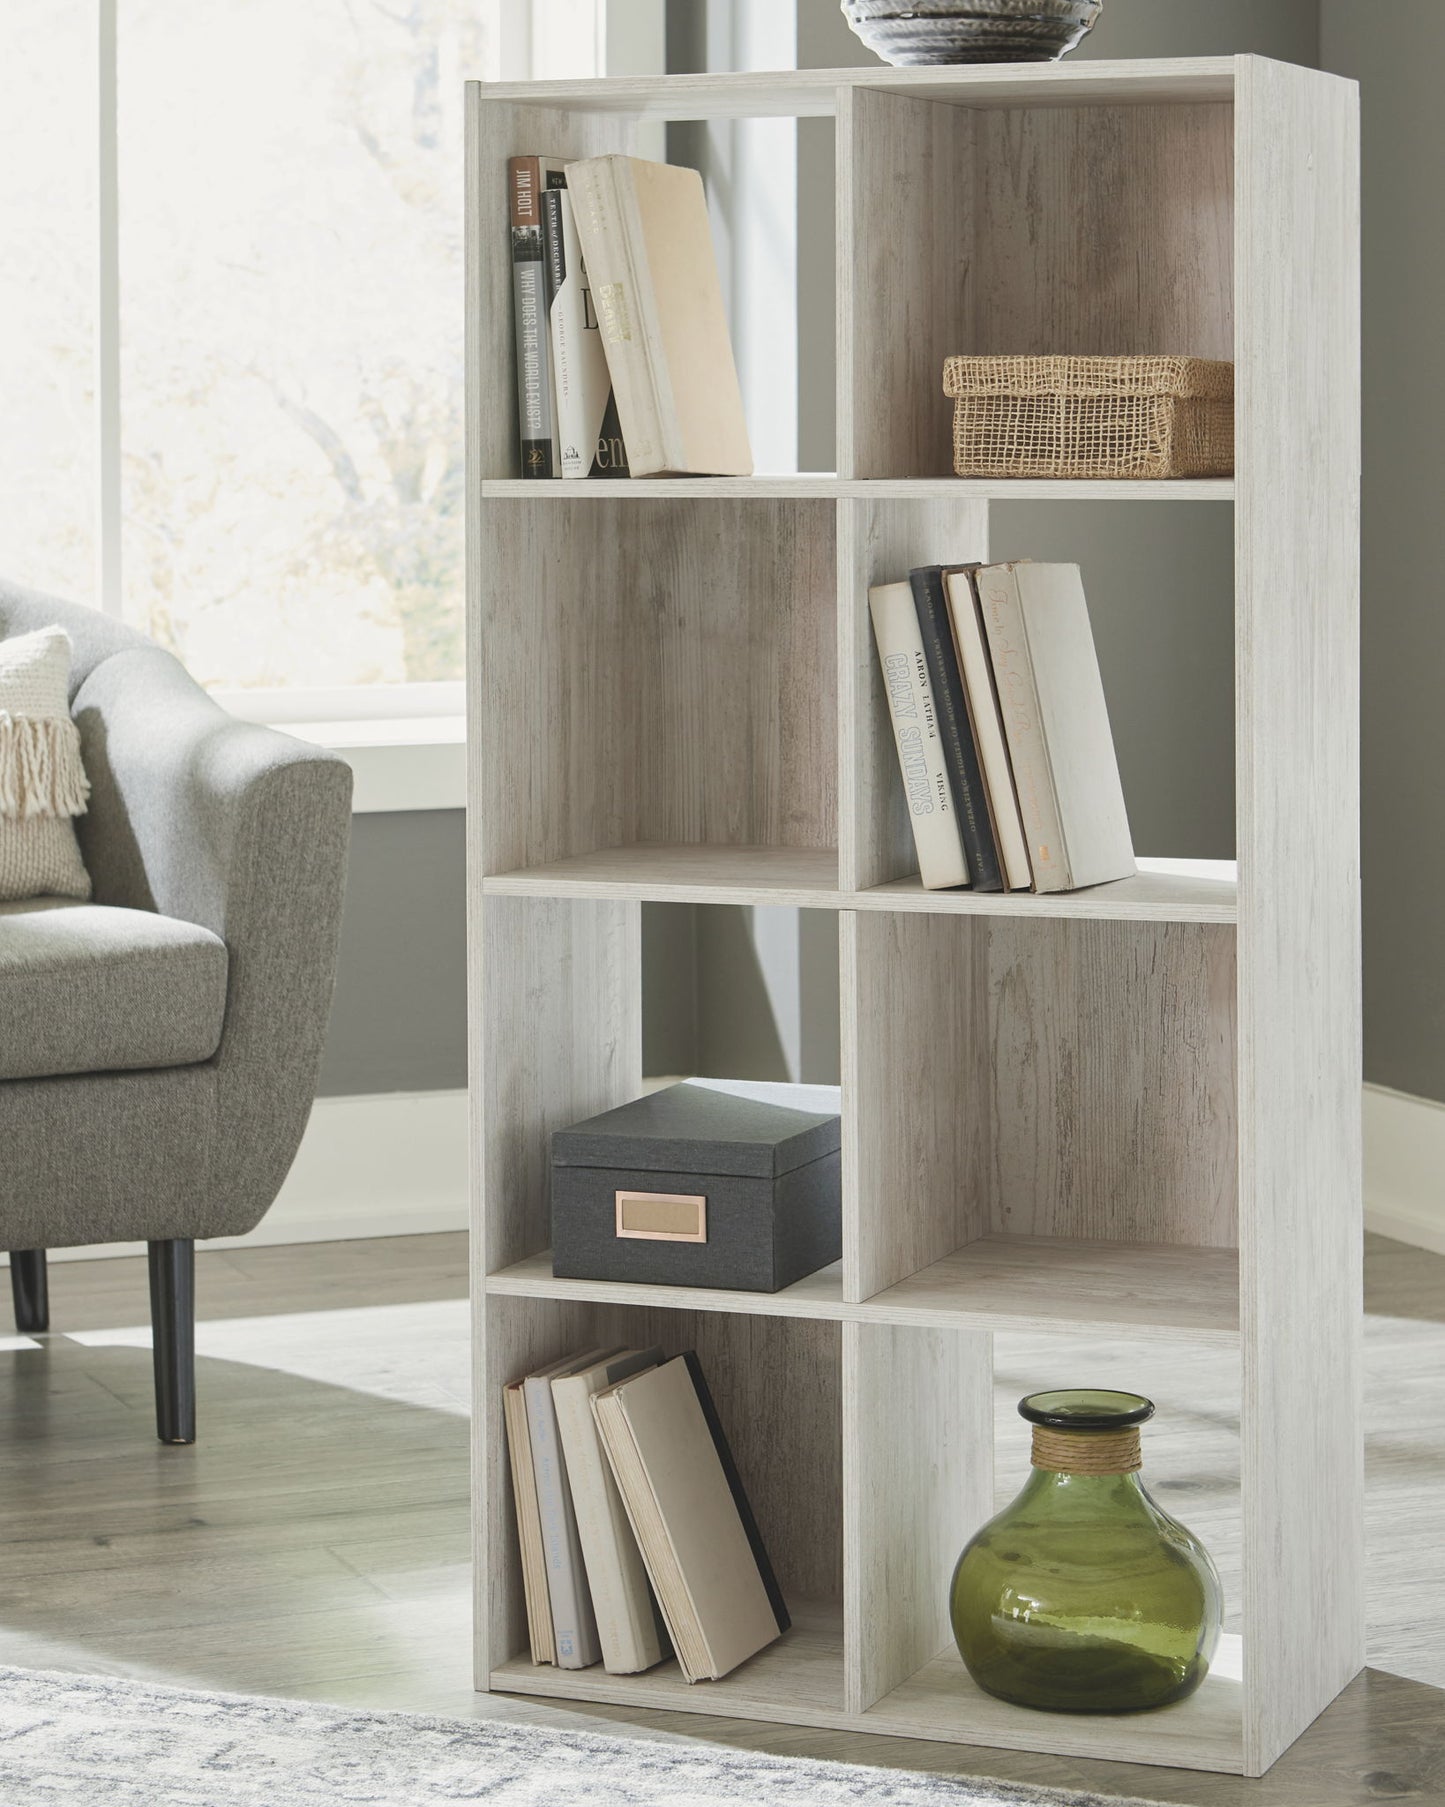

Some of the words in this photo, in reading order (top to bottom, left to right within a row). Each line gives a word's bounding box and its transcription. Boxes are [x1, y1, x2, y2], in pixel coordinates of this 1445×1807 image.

[516, 170, 531, 188] JIM
[517, 191, 532, 216] HOLT
[549, 198, 559, 228] TENTH
[520, 269, 535, 296] WHY
[522, 297, 537, 326] DOES
[557, 311, 566, 349] GEORGE
[523, 327, 538, 349] THE
[524, 350, 539, 390] WORLD
[526, 391, 541, 429] EXIST?
[885, 652, 918, 719] CRAZY
[915, 651, 928, 688] AARON
[922, 695, 937, 739] LATHAM
[899, 726, 935, 816] SUNDAYS
[936, 772, 949, 812] VIKING
